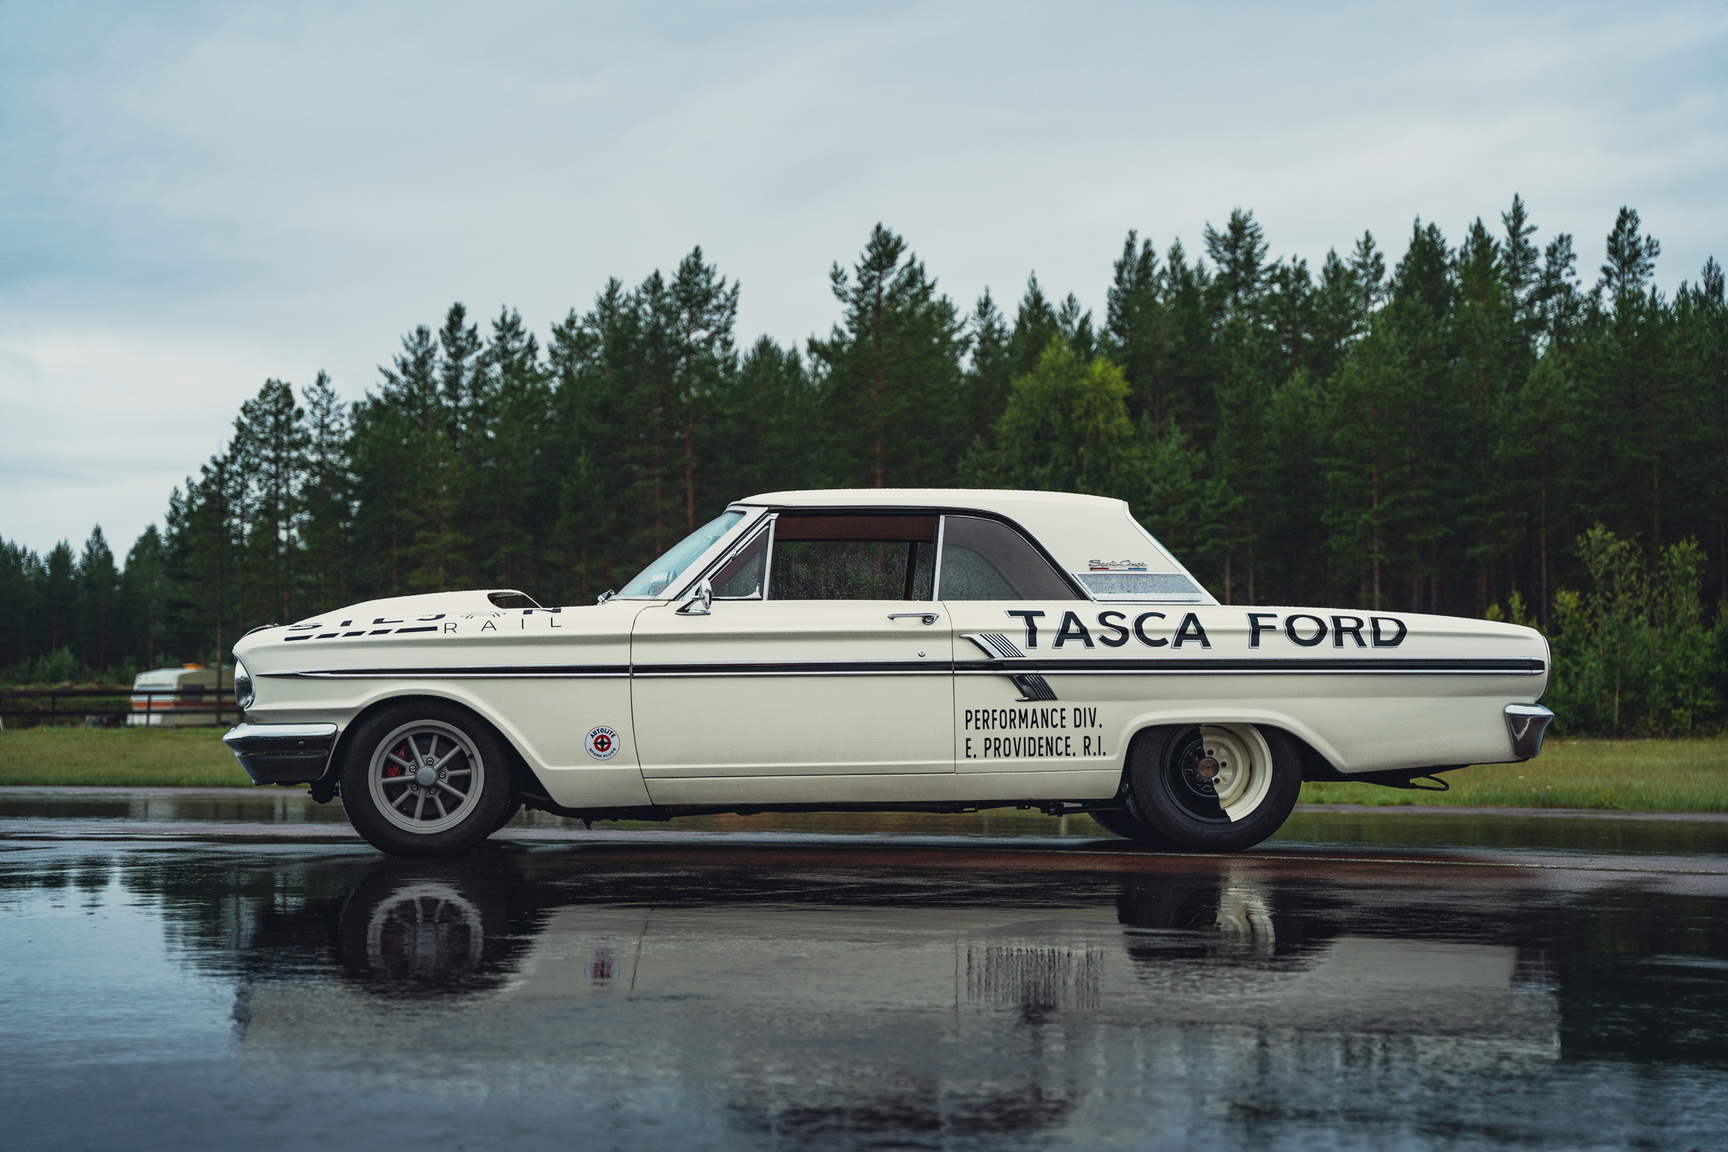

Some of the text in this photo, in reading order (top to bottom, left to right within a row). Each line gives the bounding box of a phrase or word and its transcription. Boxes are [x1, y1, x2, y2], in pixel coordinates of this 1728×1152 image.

[443, 616, 562, 634] RAIL
[1004, 610, 1408, 649] TASCA FORD
[965, 707, 1103, 730] PERFORMANCE DIV.
[590, 727, 617, 739] AUTOLITE
[965, 737, 977, 758] E.
[1083, 735, 1107, 757] R.I.
